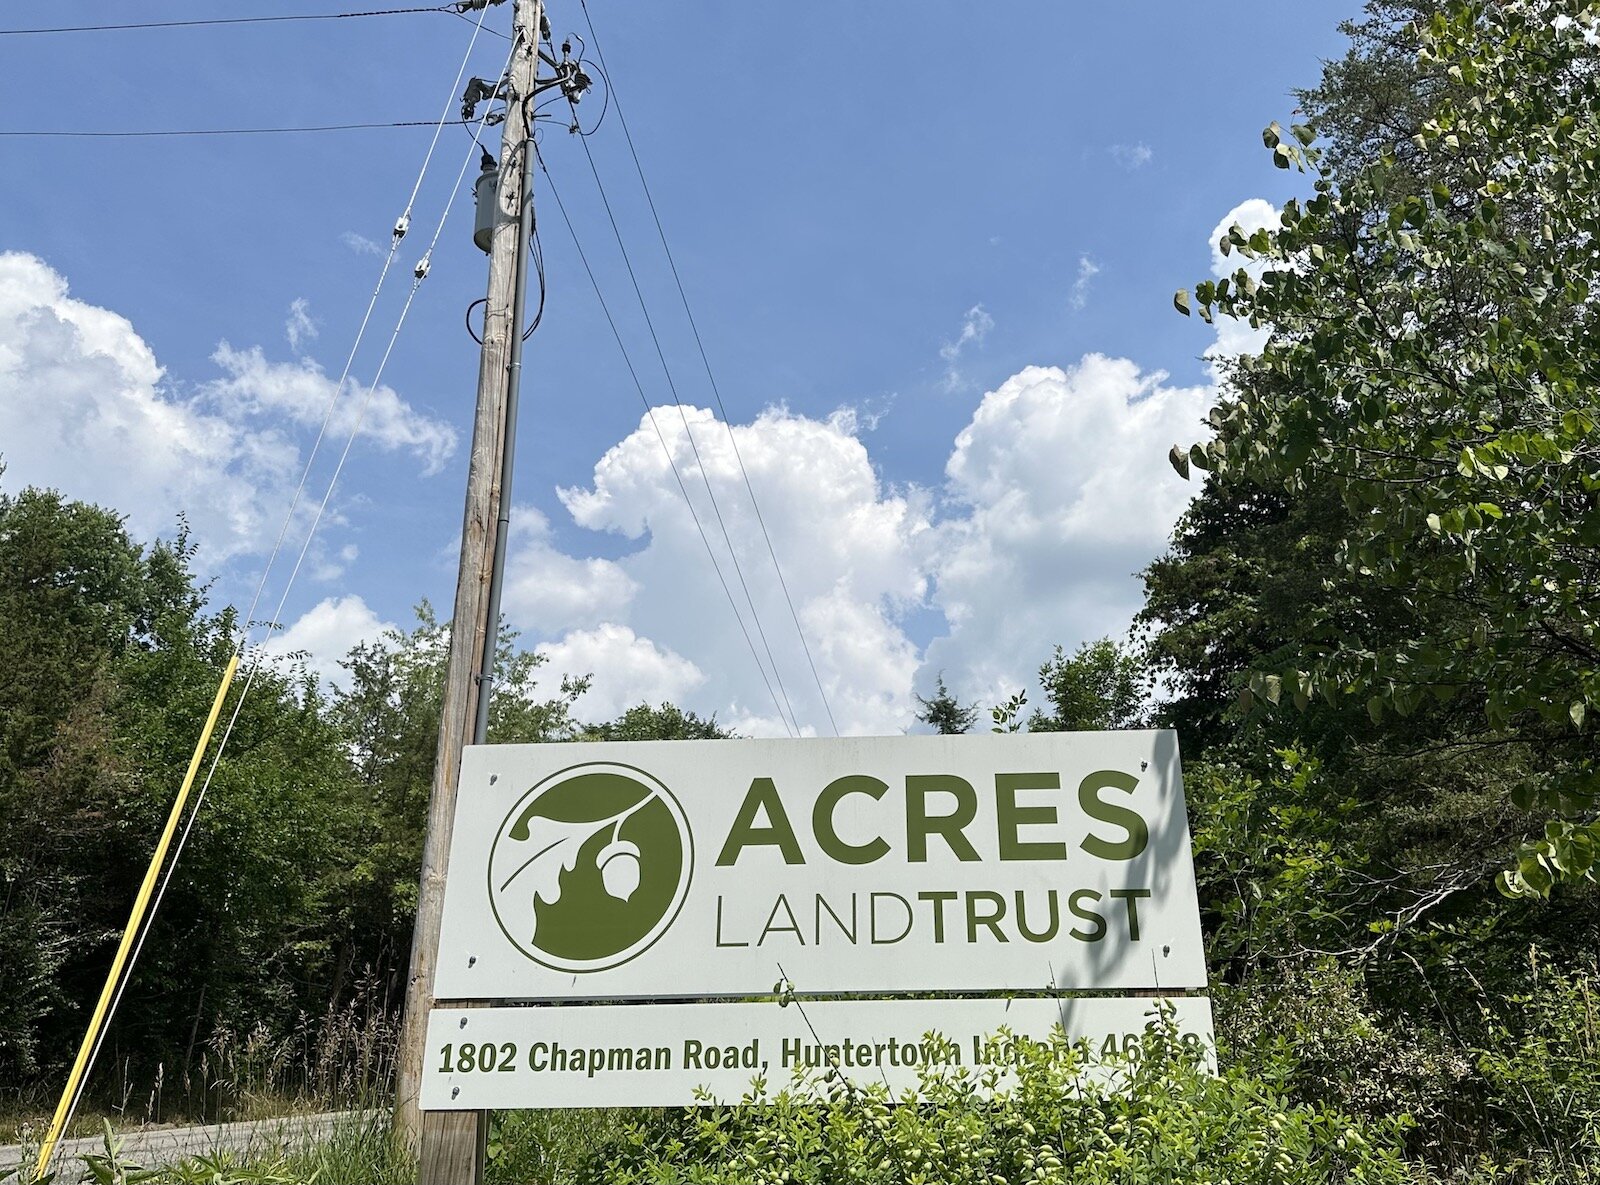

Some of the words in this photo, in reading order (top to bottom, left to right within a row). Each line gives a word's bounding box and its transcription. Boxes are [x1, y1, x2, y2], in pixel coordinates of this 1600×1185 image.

[715, 770, 1149, 867] ACRES
[438, 1042, 517, 1073] 1802
[528, 1041, 672, 1078] Chapman
[683, 1038, 768, 1073] Road,
[781, 1037, 961, 1067] Huntertown
